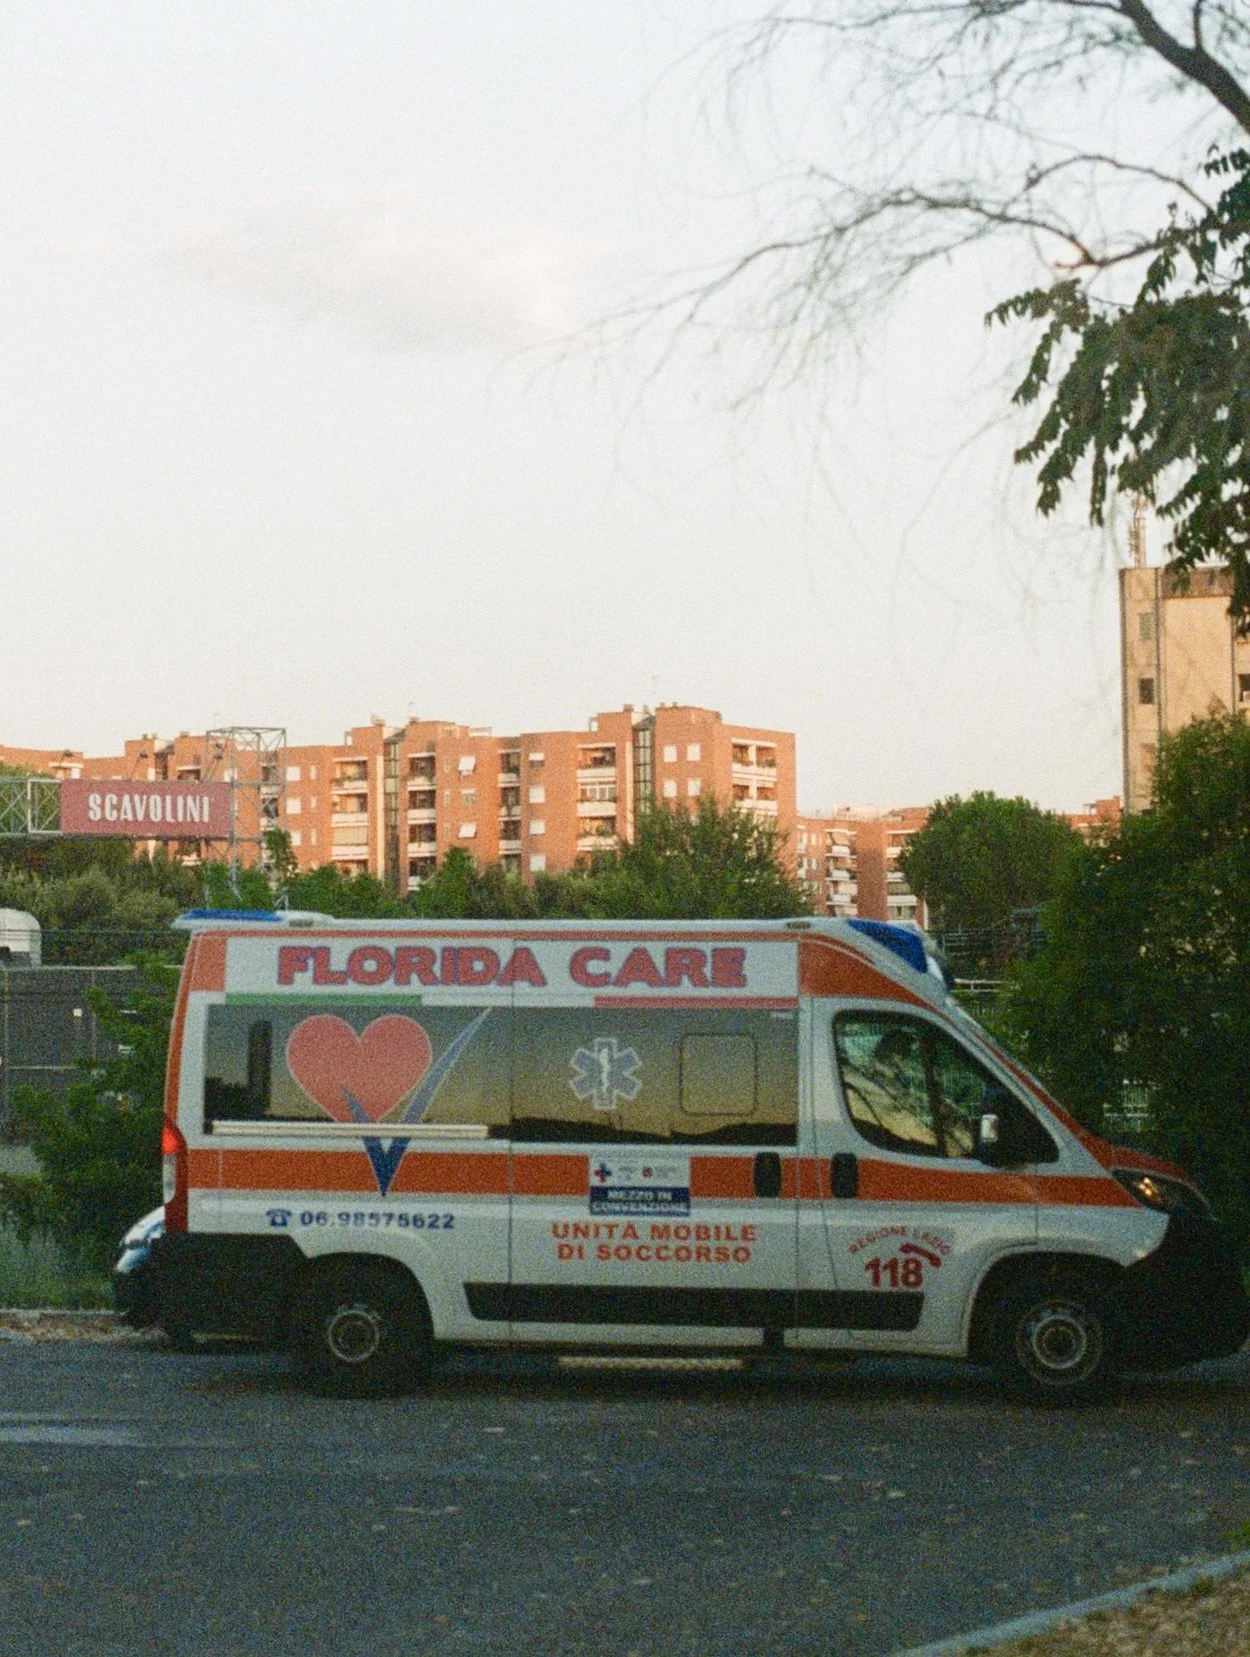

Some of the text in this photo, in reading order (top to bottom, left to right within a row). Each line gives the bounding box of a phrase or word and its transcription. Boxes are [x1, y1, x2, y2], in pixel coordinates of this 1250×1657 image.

[88, 793, 210, 823] SCAVOLINI
[276, 945, 748, 989] FLORIDA CARE
[650, 1223, 758, 1242] MOBILE
[557, 1243, 752, 1263] DI SOCCORSO
[864, 1256, 923, 1288] 118
